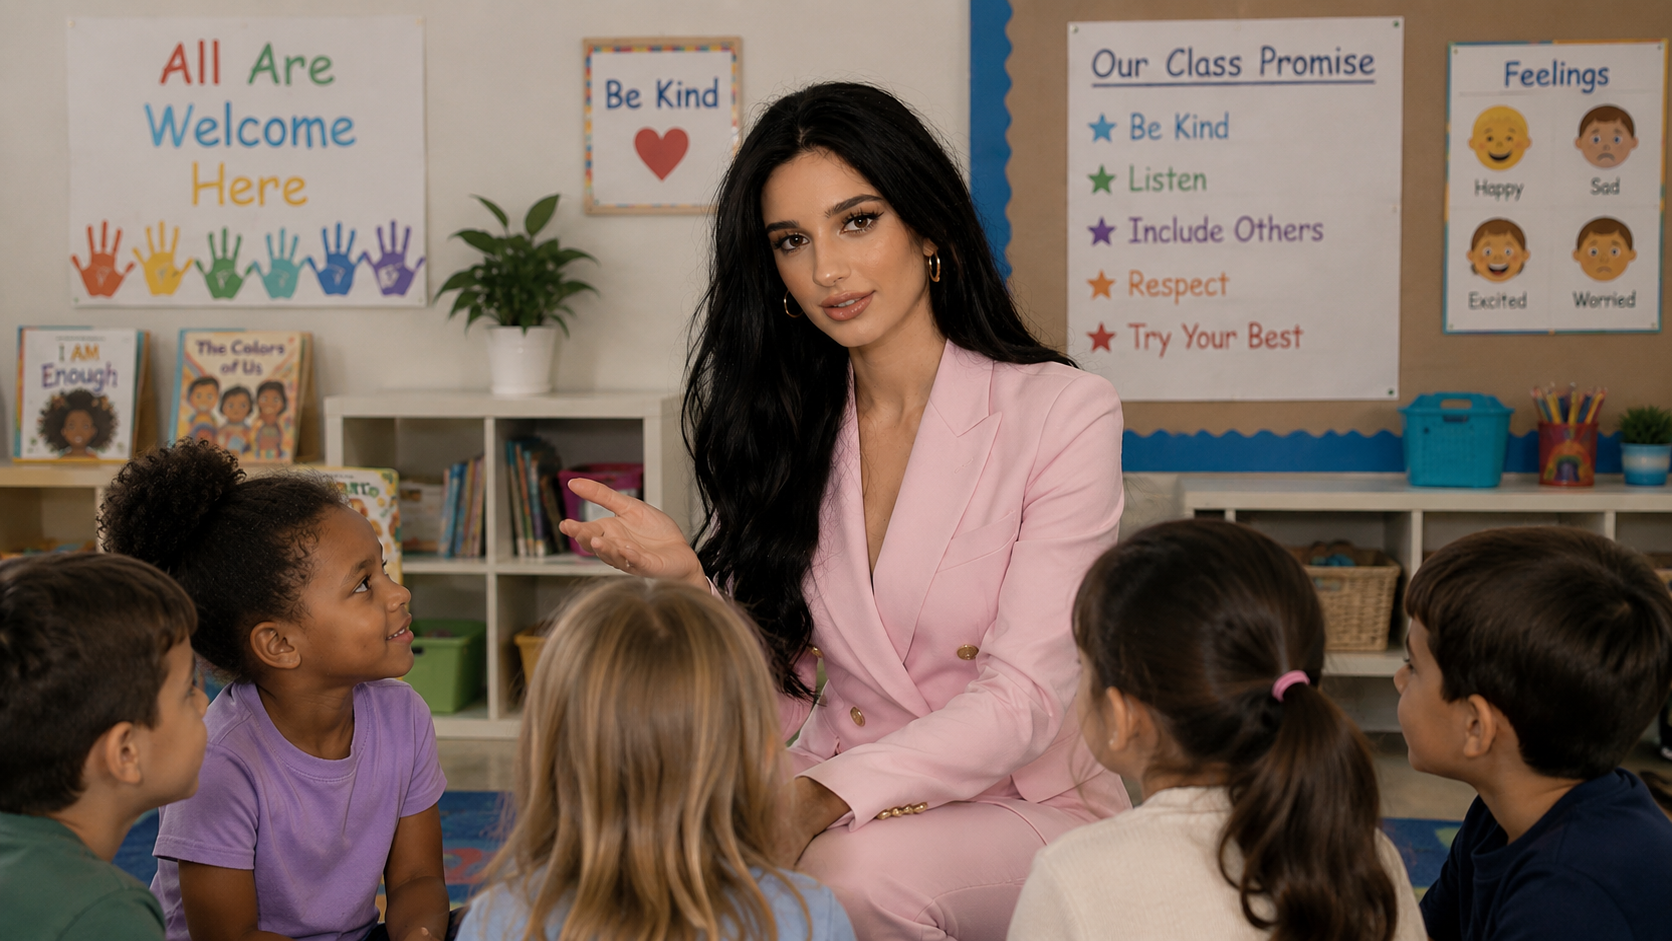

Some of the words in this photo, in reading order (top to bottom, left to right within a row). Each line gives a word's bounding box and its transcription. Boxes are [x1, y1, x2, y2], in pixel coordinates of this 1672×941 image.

[160, 40, 219, 85] All
[248, 43, 334, 85] Are
[1092, 49, 1148, 78] Our
[1166, 47, 1242, 77] Class
[1260, 46, 1374, 76] Promise
[1505, 59, 1609, 93] Feelings
[606, 79, 641, 109] Be
[657, 78, 718, 108] Kind
[145, 101, 356, 148] Welcome
[1130, 112, 1162, 141] Be
[1175, 112, 1229, 140] Kind
[192, 162, 307, 206] Here
[1129, 165, 1206, 192] Listen
[1474, 179, 1524, 202] Happy
[1591, 177, 1620, 195] Sad
[1129, 216, 1223, 244] Include
[1234, 215, 1323, 242] Others
[1129, 270, 1229, 305] Respect
[1468, 291, 1528, 310] Excited
[1573, 291, 1636, 308] Worried
[58, 344, 66, 362] I
[71, 344, 100, 362] AM
[196, 340, 227, 356] The
[231, 339, 285, 355] Colors
[1128, 323, 1171, 358] Try
[1182, 324, 1237, 349] Your
[1249, 322, 1303, 349] Best
[41, 361, 118, 393] Enough
[220, 359, 239, 375] of
[242, 360, 263, 375] Us
